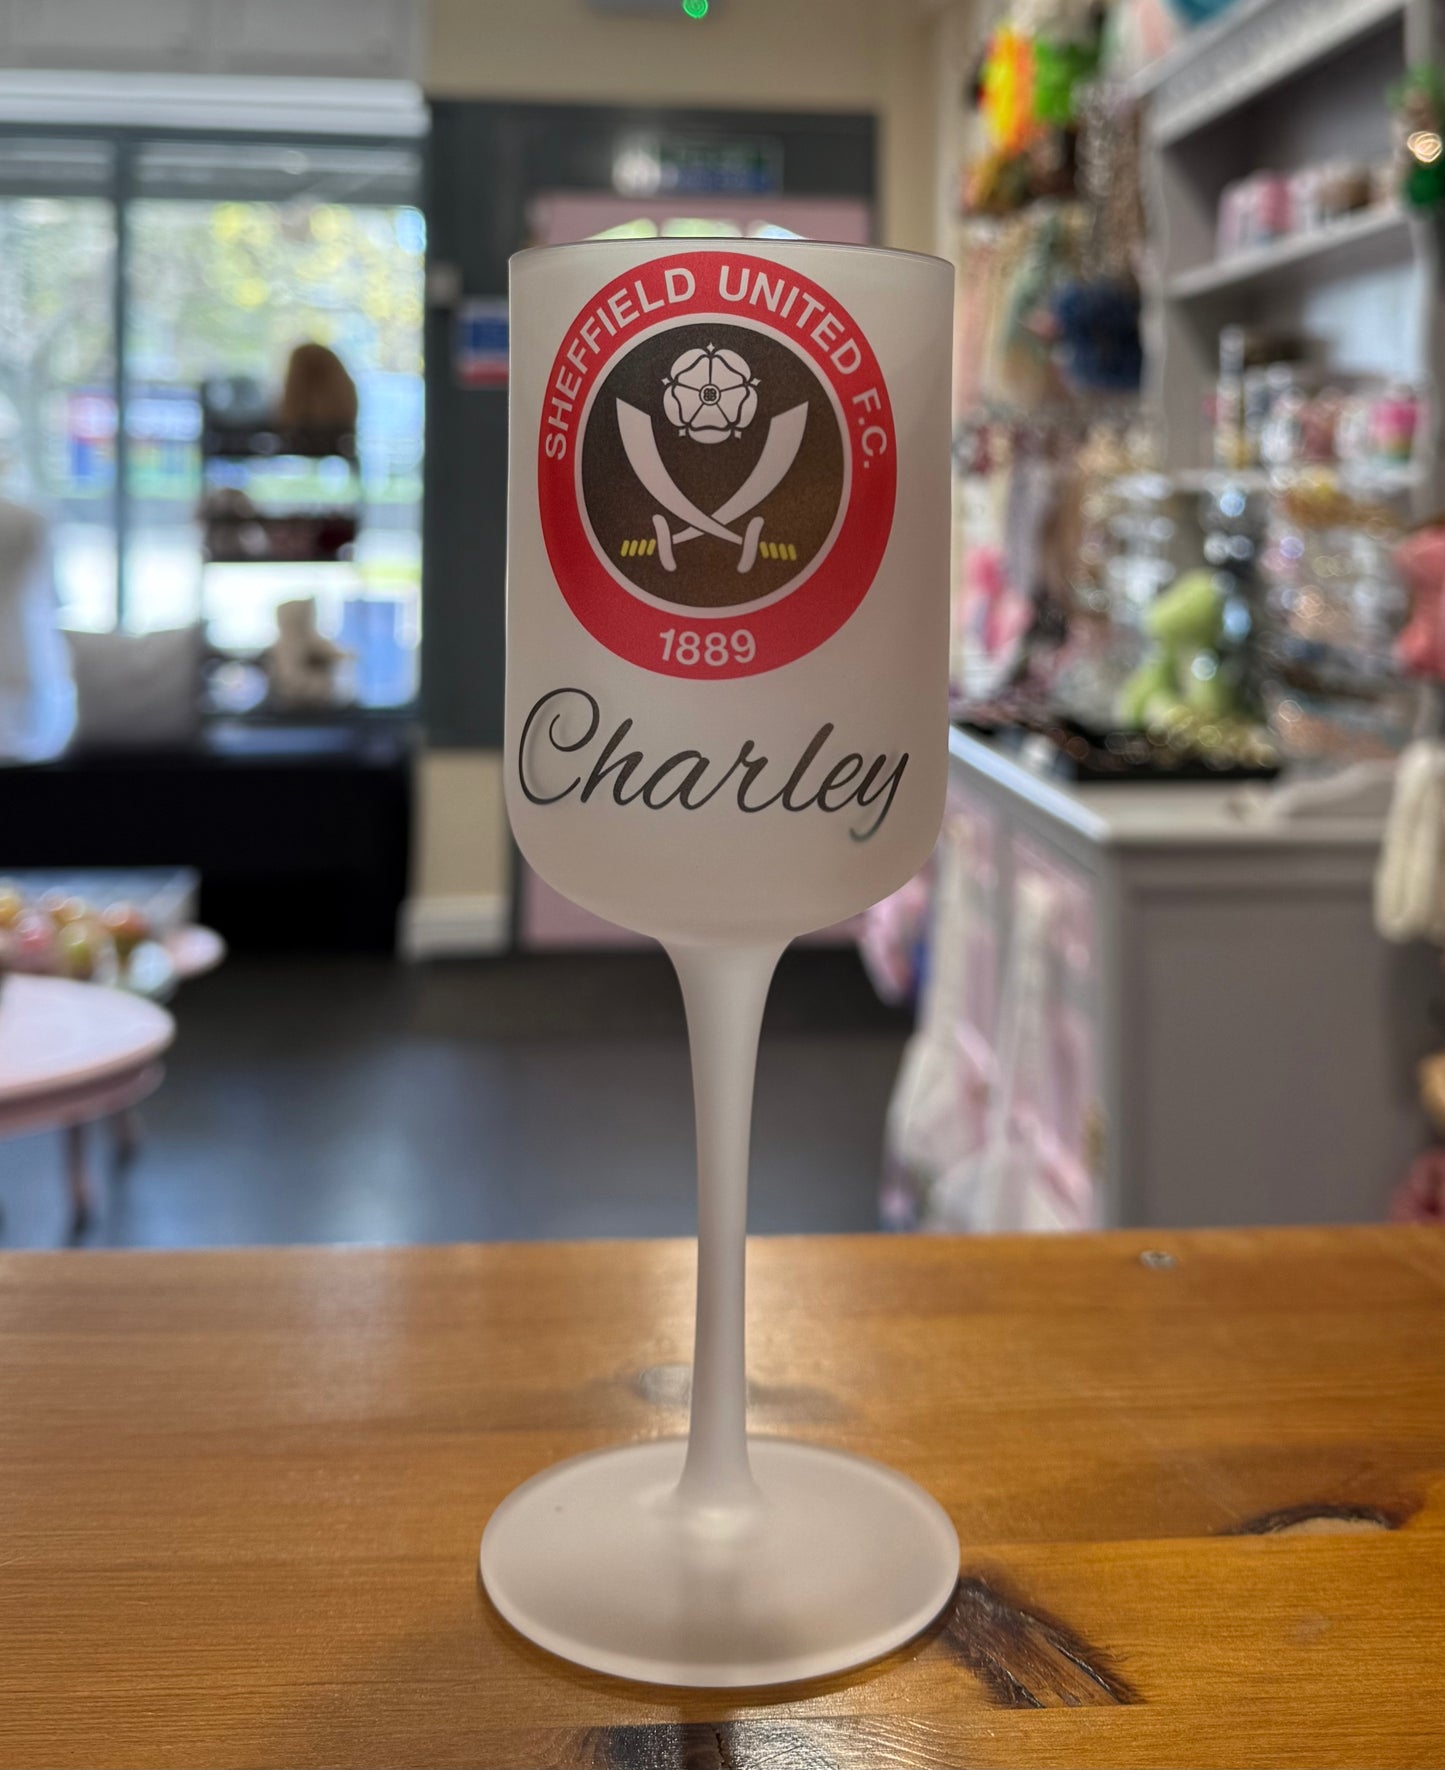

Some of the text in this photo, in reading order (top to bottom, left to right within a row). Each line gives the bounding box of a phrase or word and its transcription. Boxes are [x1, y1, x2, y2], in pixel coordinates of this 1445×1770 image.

[545, 265, 888, 469] SHEFFIELD UNITED F.C.
[659, 628, 757, 668] 1889
[518, 687, 910, 843] Charley
